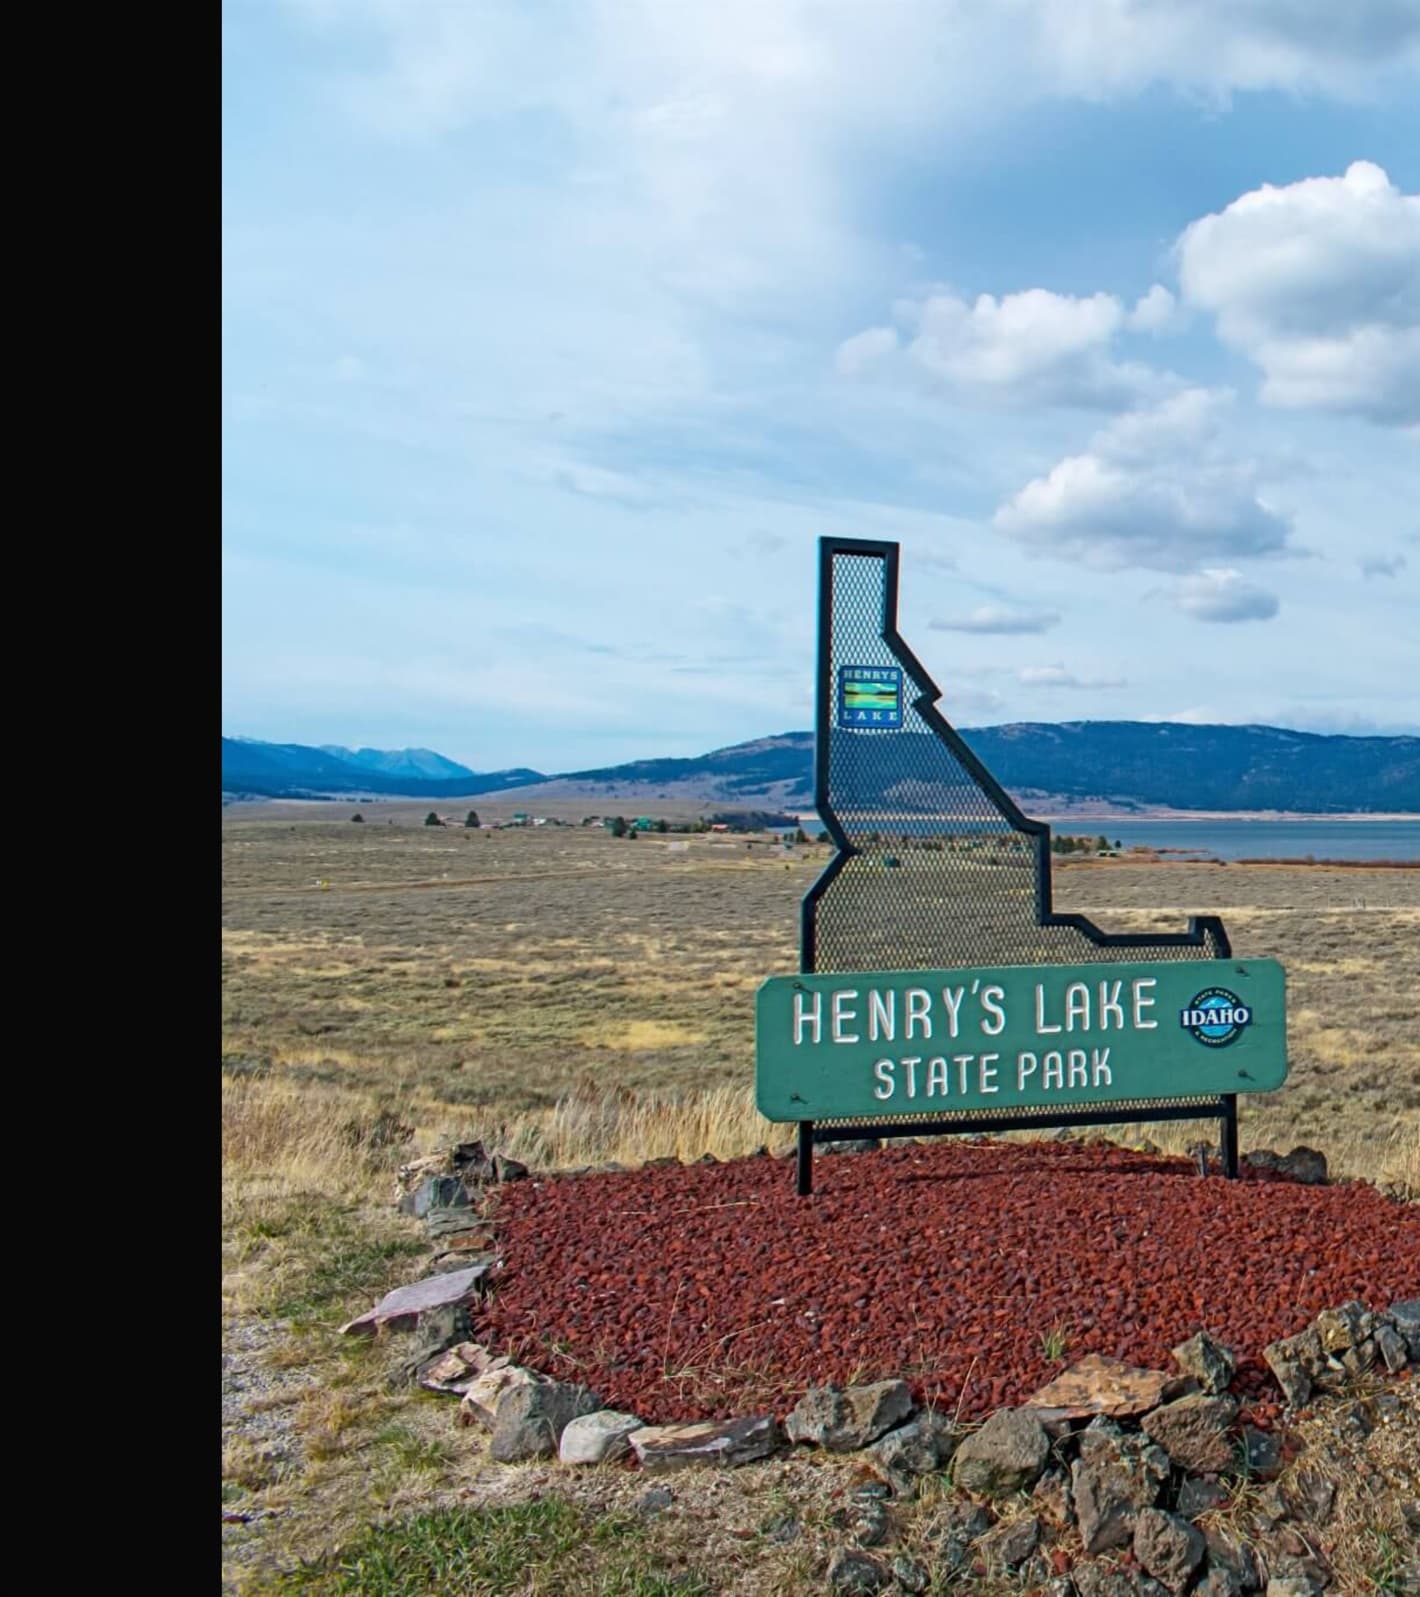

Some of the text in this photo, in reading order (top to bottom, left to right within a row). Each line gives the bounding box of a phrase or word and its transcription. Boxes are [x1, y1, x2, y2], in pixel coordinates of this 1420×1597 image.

[843, 670, 897, 680] HENRYS
[843, 711, 898, 720] LAKE
[792, 977, 1159, 1044] HENRY'S LAKE
[1183, 1008, 1249, 1026] IDAHO
[873, 1048, 1113, 1100] STATE PARK
